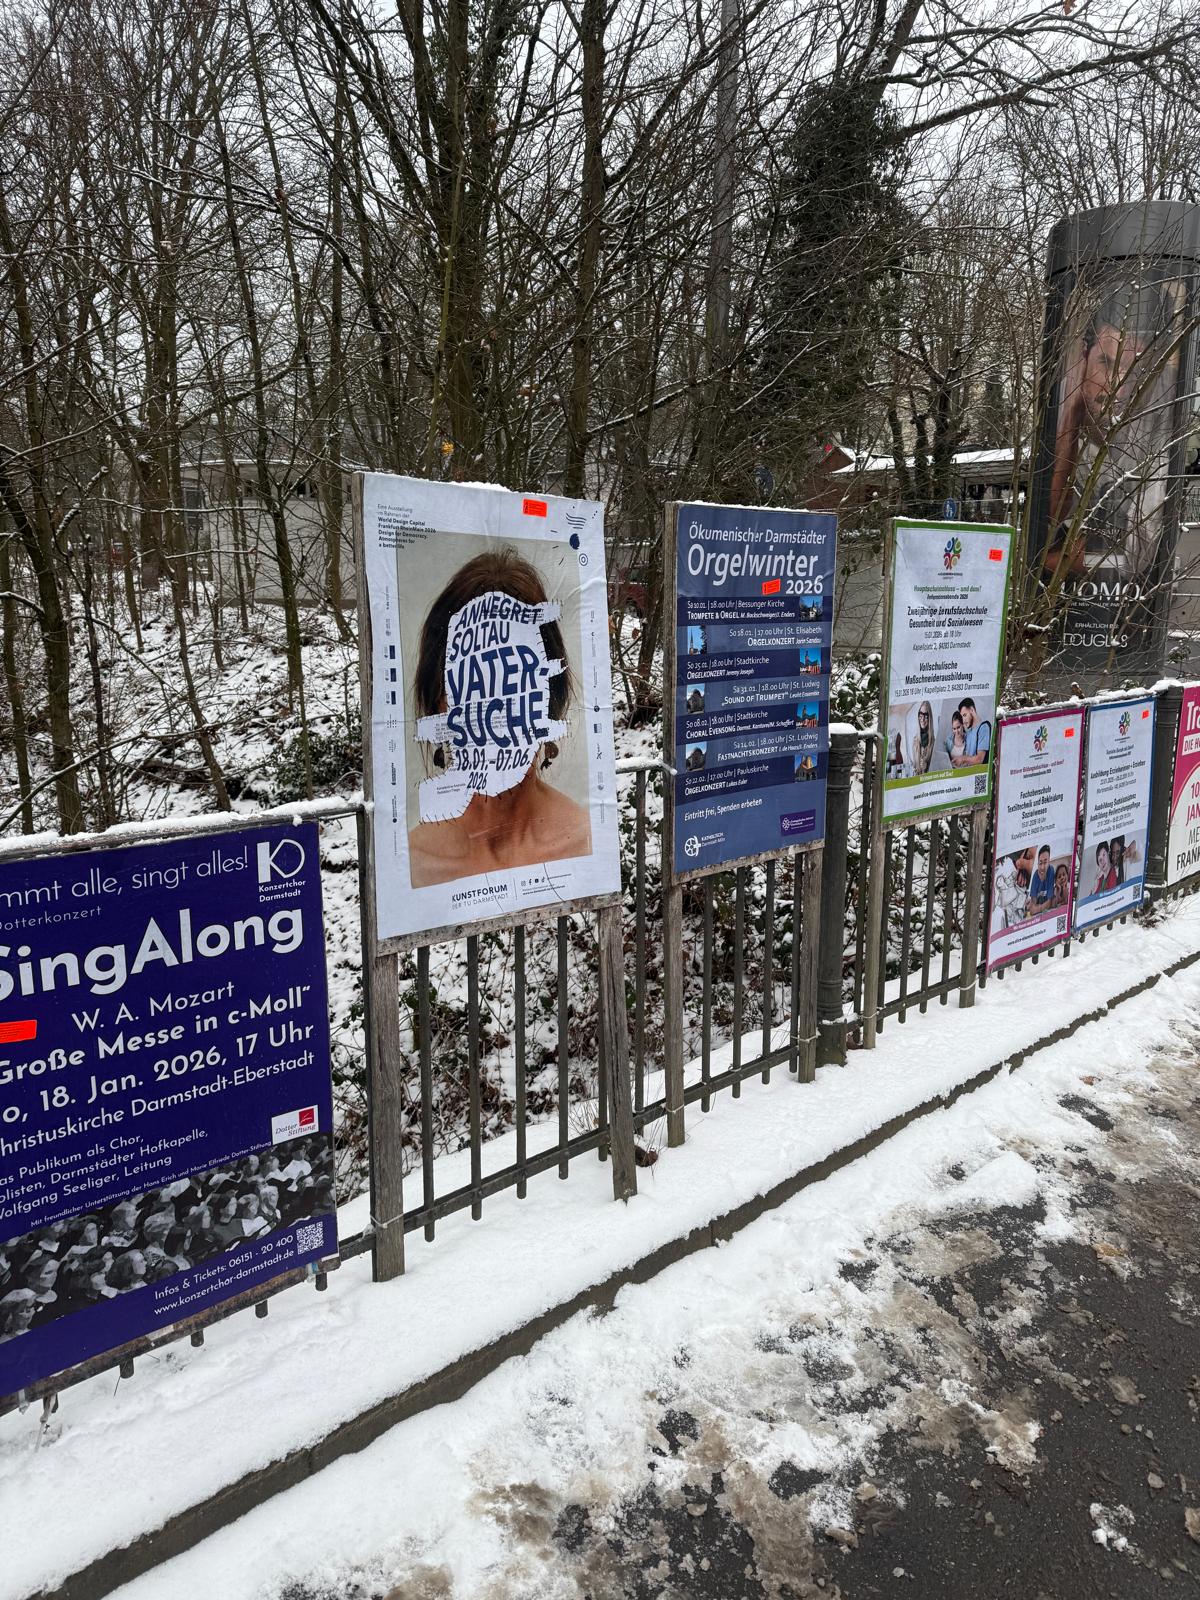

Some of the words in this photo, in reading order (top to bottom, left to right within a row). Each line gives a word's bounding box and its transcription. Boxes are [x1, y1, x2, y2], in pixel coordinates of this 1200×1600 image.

[689, 522, 763, 543] Ökumenischer
[766, 529, 827, 545] Darmstädter
[688, 544, 818, 586] Orgelwinter
[786, 575, 823, 595] 2026
[455, 596, 541, 632] ANNEGRET
[738, 600, 767, 610] Bessunger
[768, 600, 784, 608] Kirche
[688, 612, 715, 620] TROMPETE
[720, 611, 739, 619] ORGEL
[947, 618, 983, 627] Sozialwesen
[773, 627, 783, 636] Uhr
[796, 626, 822, 634] Elisabeth
[449, 621, 510, 662] SOLTAU
[748, 637, 795, 647] ORGELKONZERT
[1064, 633, 1128, 648] DOUGLS
[724, 659, 734, 667] Uhr
[737, 657, 770, 666] Stadtkirche
[447, 645, 549, 706] VATER-
[687, 670, 726, 680] ORGELKONZERT
[779, 682, 789, 690] Uhr
[802, 680, 820, 688] Ludwig
[964, 683, 990, 691] Darmstadt
[447, 691, 549, 748] SUCHE
[724, 716, 734, 724] Uhr
[737, 711, 769, 720] Stadtkirche
[686, 729, 708, 739] CHORAL
[709, 725, 736, 736] EVENSONG
[775, 735, 785, 744] Uhr
[788, 734, 796, 742] St.
[797, 732, 818, 741] Ludwig
[456, 748, 530, 771] 18.01.–07.06.
[718, 746, 778, 762] FASTNACHTSKONZERT
[723, 770, 733, 778] Uhr
[737, 764, 769, 776] Pauluskirche
[467, 772, 488, 790] 2026
[685, 781, 726, 796] ORGELKONZERT
[685, 809, 705, 821] Eintritt
[705, 807, 717, 819] frei,
[717, 802, 740, 815] Spenden
[741, 798, 763, 809] erbeten
[72, 868, 123, 898] alle,
[132, 862, 189, 889] singt
[197, 845, 249, 878] alles!
[258, 878, 306, 893] Konzertchor
[452, 884, 508, 903] KUNSTFORUM
[259, 888, 301, 903] Darmstadt
[473, 892, 509, 906] DARMSTADT
[0, 906, 102, 931] otterkonzert
[72, 1009, 104, 1033] W.
[115, 1003, 139, 1026] A.
[150, 981, 235, 1017] Mozart
[0, 1048, 86, 1085] Große
[98, 1023, 185, 1059] Messe
[195, 1014, 218, 1034] in
[40, 1086, 76, 1112] 18.
[88, 1074, 144, 1103] Jan.
[153, 1047, 227, 1082] 2026,
[236, 1033, 258, 1057] 17
[269, 1021, 314, 1048] Uhr
[0, 1104, 125, 1157] hristuskirche
[132, 1051, 315, 1118] Darmstadt-Eberstadt
[276, 1124, 297, 1134] Dotter
[288, 1125, 316, 1136] Stiftung
[19, 1153, 82, 1179] Publikum
[86, 1142, 106, 1158] als
[109, 1134, 145, 1151] Chor,
[50, 1152, 135, 1185] Darmstädter
[140, 1129, 209, 1157] Hofkapelle,
[63, 1171, 120, 1196] Seeliger,
[124, 1154, 172, 1177] Leitung
[31, 1218, 43, 1228] Mit
[44, 1204, 84, 1224] freundlicher
[85, 1190, 131, 1209] Unterstützung
[132, 1183, 143, 1193] der
[144, 1178, 160, 1188] Hans
[161, 1172, 177, 1183] Erich
[178, 1168, 190, 1178] und
[191, 1163, 208, 1174] Marie
[155, 1286, 180, 1301] Infos
[183, 1279, 191, 1289] &
[193, 1265, 227, 1284] Tickets:
[229, 1252, 253, 1268] 06151
[261, 1243, 274, 1254] 20
[275, 1235, 294, 1248] 400
[154, 1250, 294, 1315] www.konzertchor-darmstadt.de
